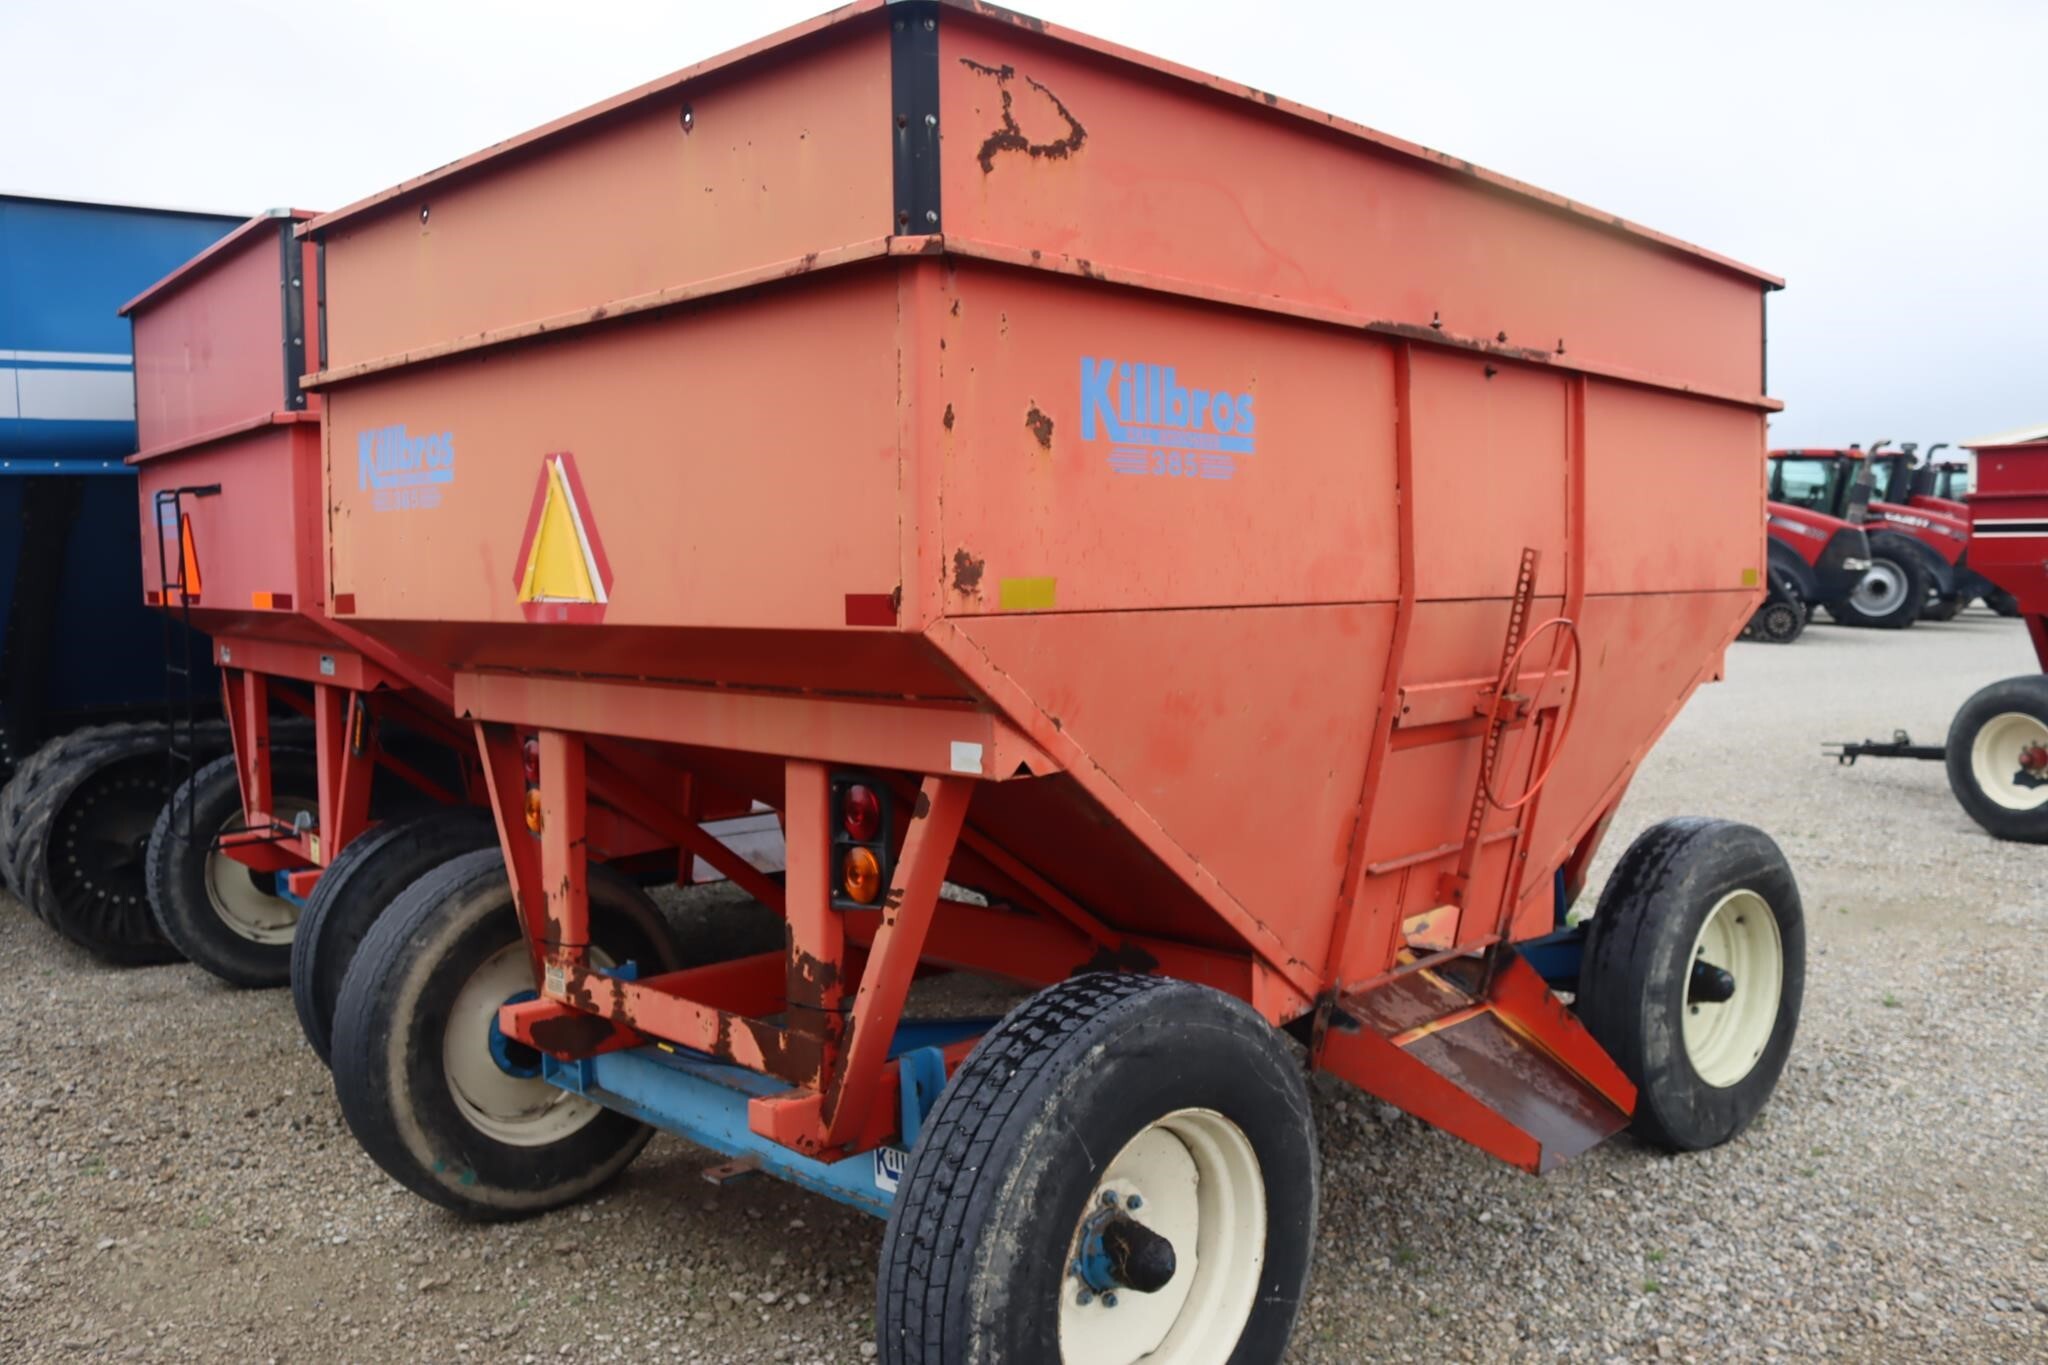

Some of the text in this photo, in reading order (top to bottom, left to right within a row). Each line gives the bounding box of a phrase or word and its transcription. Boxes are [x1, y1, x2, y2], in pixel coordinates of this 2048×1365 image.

[1080, 356, 1256, 444] Killbros
[358, 425, 454, 491] Killbros
[1152, 450, 1198, 478] 385
